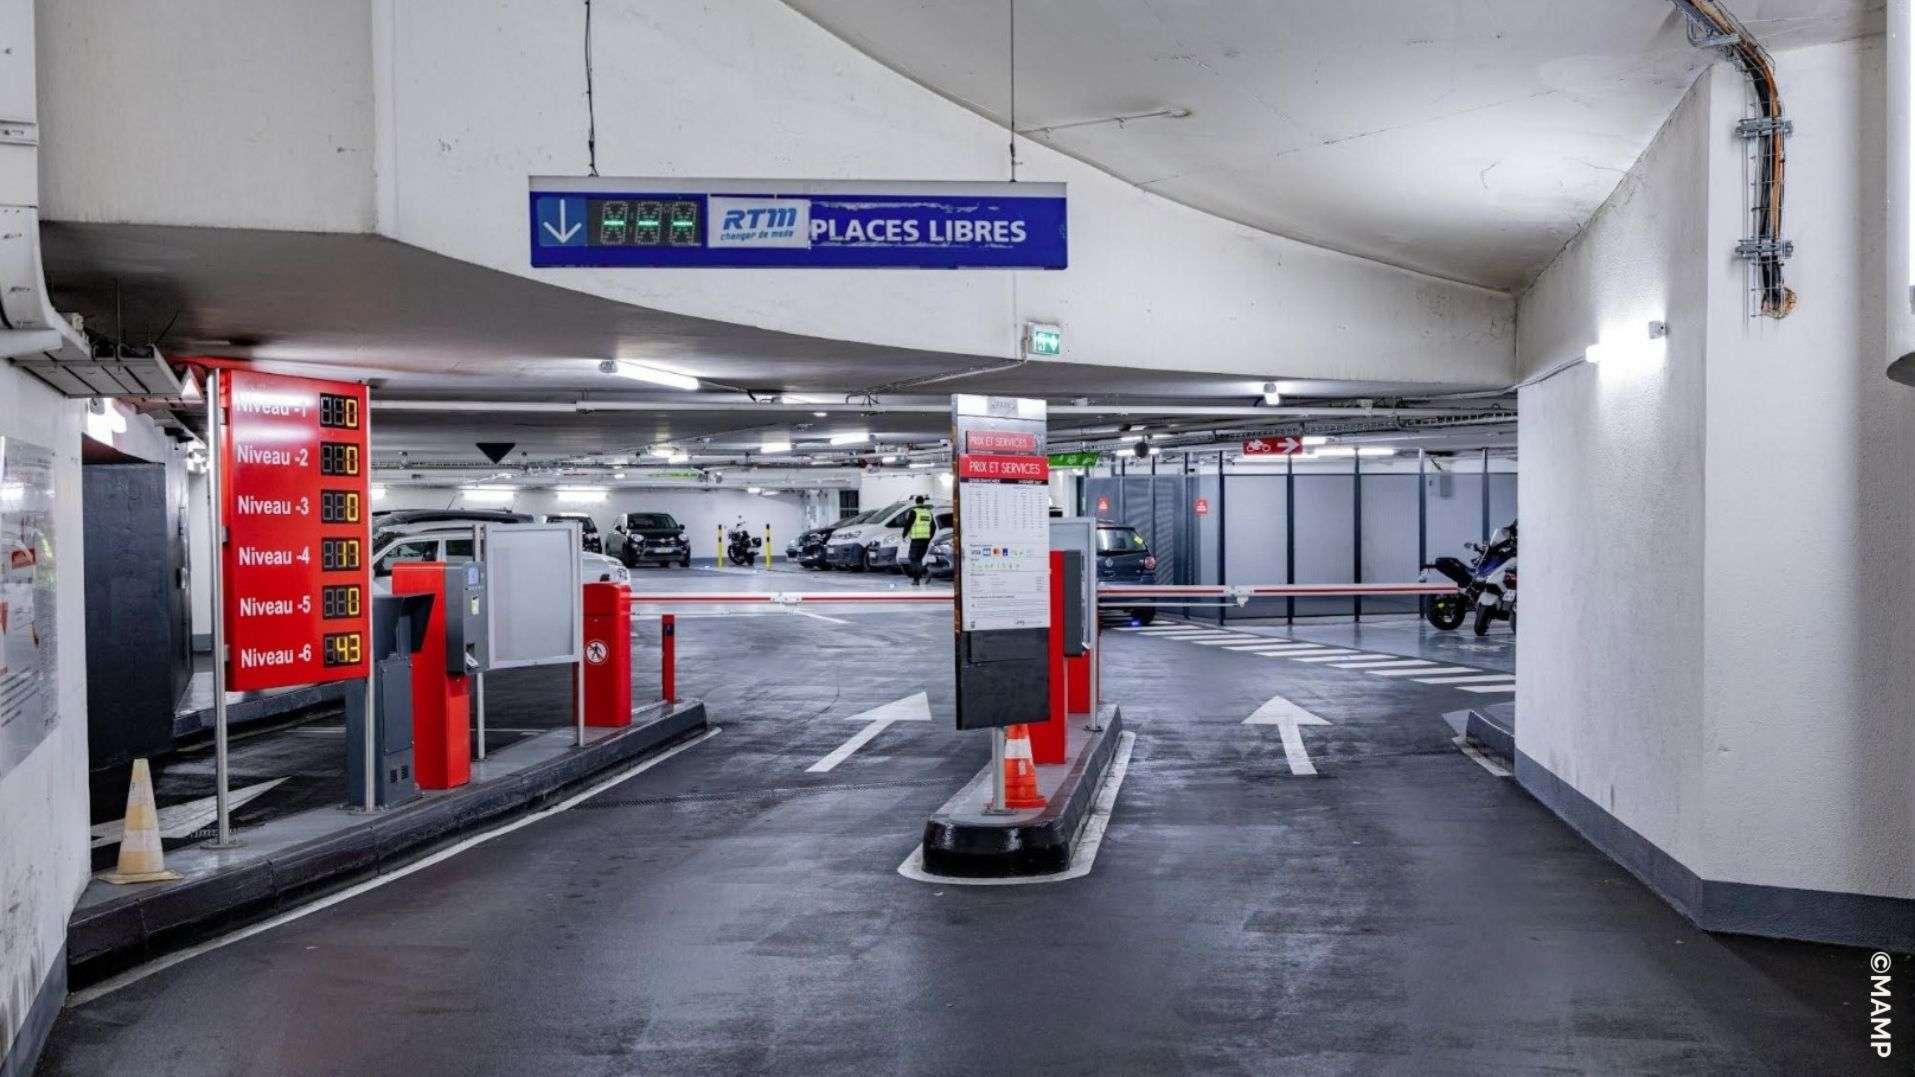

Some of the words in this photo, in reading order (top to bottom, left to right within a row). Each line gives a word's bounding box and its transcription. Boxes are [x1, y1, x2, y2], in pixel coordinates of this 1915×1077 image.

[811, 218, 920, 242] PLACES
[929, 219, 1027, 243] LIBRES
[346, 398, 358, 427] 0
[237, 445, 290, 466] Niveau
[294, 448, 309, 467] -2
[346, 446, 358, 475] 0
[969, 461, 987, 473] PRIX
[989, 462, 999, 473] ET
[1001, 462, 1040, 475] SERVICES
[238, 495, 291, 515] Niveau
[295, 496, 310, 516] -3
[346, 493, 359, 522] 0
[239, 546, 292, 565] Niveau
[296, 545, 311, 565] -4
[342, 540, 359, 568] 17
[240, 597, 293, 617] Niveau
[297, 595, 311, 614] -5
[348, 587, 360, 615] 0
[240, 648, 294, 669] Niveau
[298, 643, 312, 662] -6
[336, 633, 361, 663] 43
